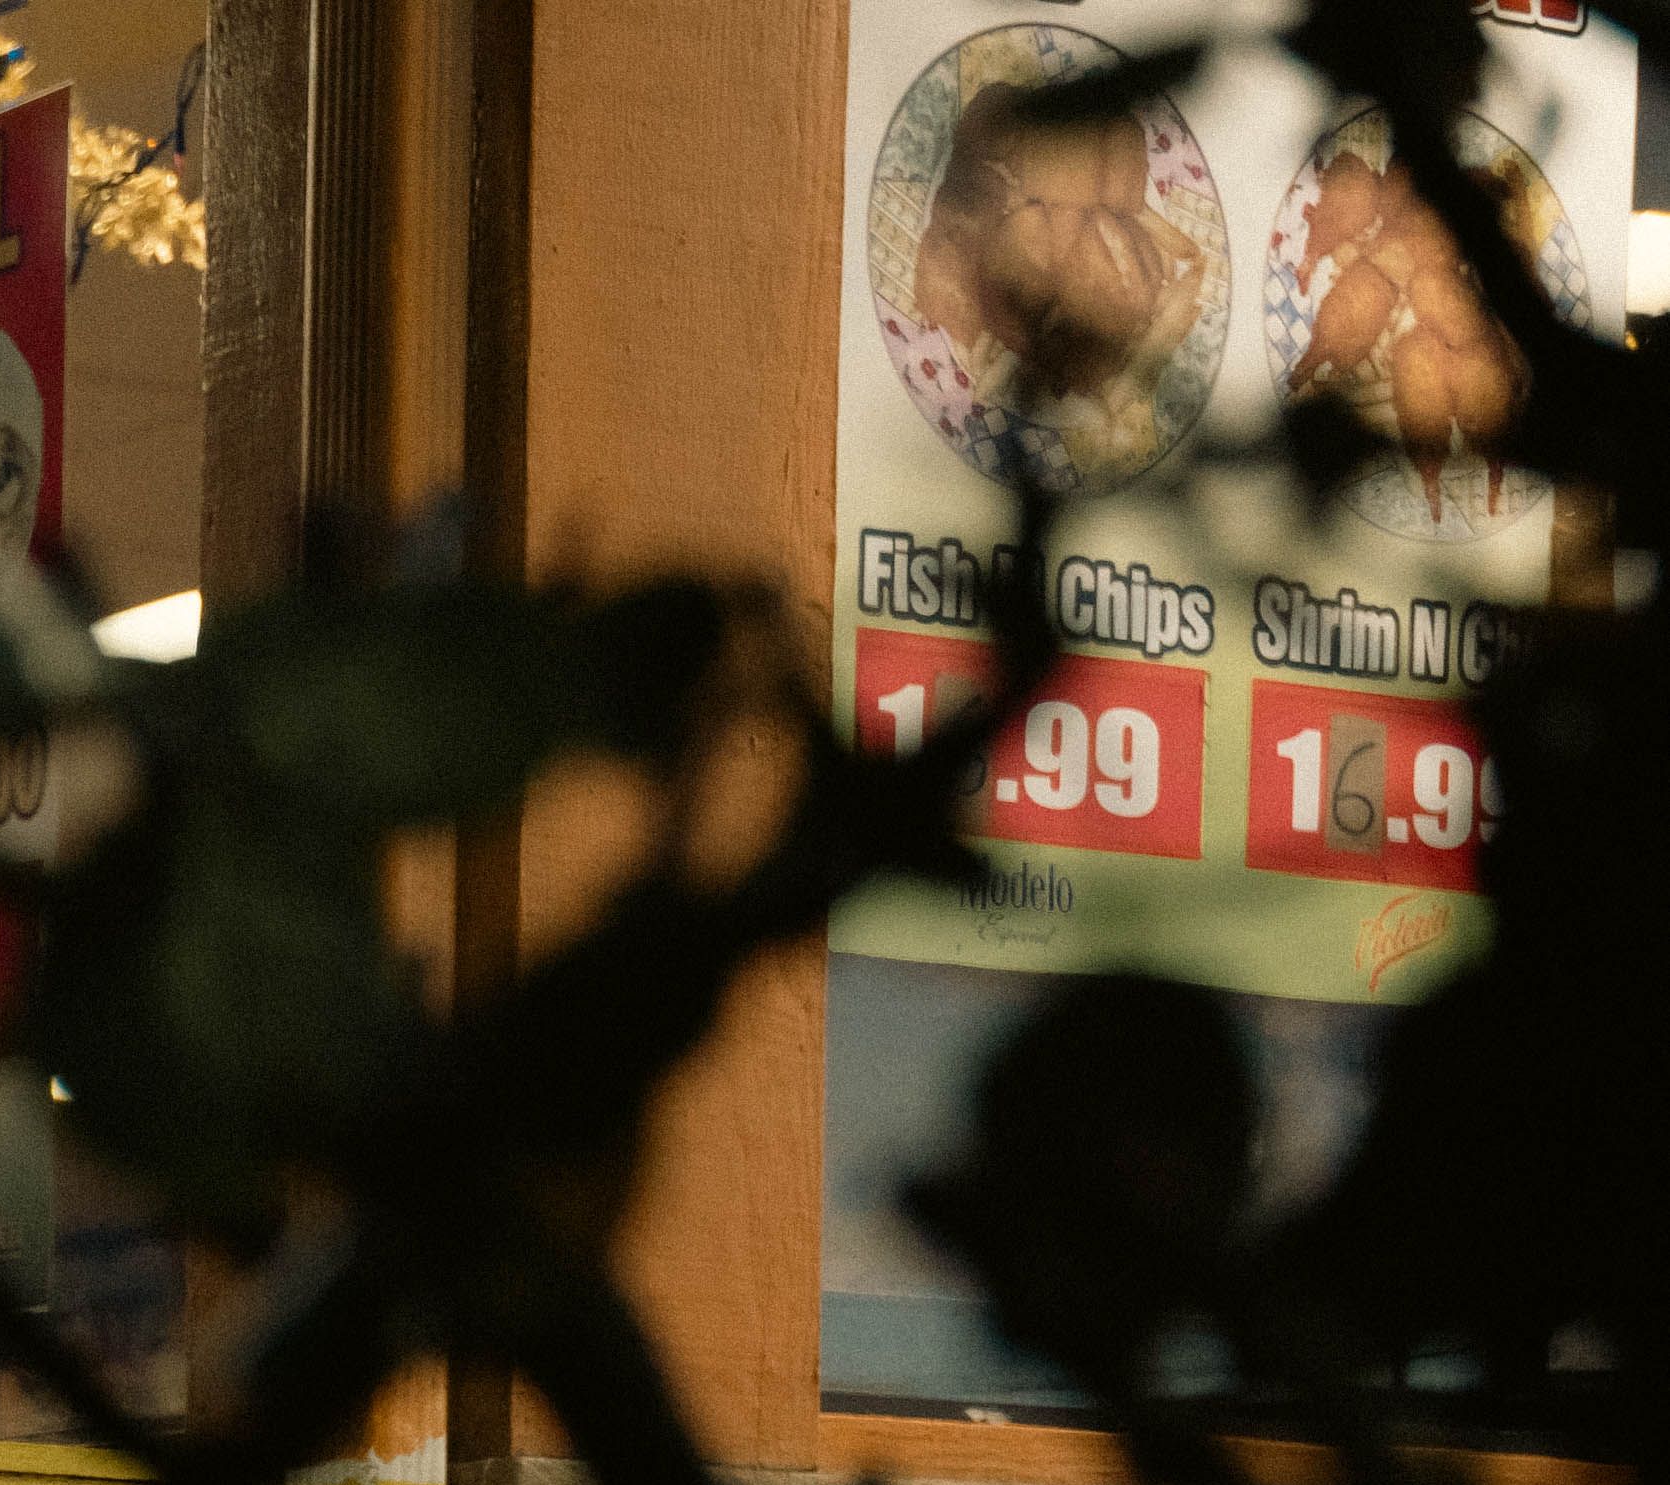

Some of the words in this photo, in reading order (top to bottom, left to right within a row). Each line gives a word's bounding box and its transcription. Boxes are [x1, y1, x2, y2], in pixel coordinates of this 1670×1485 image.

[857, 527, 981, 627] Fish
[1056, 555, 1215, 659] Chips
[1252, 573, 1401, 682] Shrim
[1409, 597, 1451, 684] N
[877, 682, 1161, 819] 1.99
[957, 858, 1075, 914] Modelo
